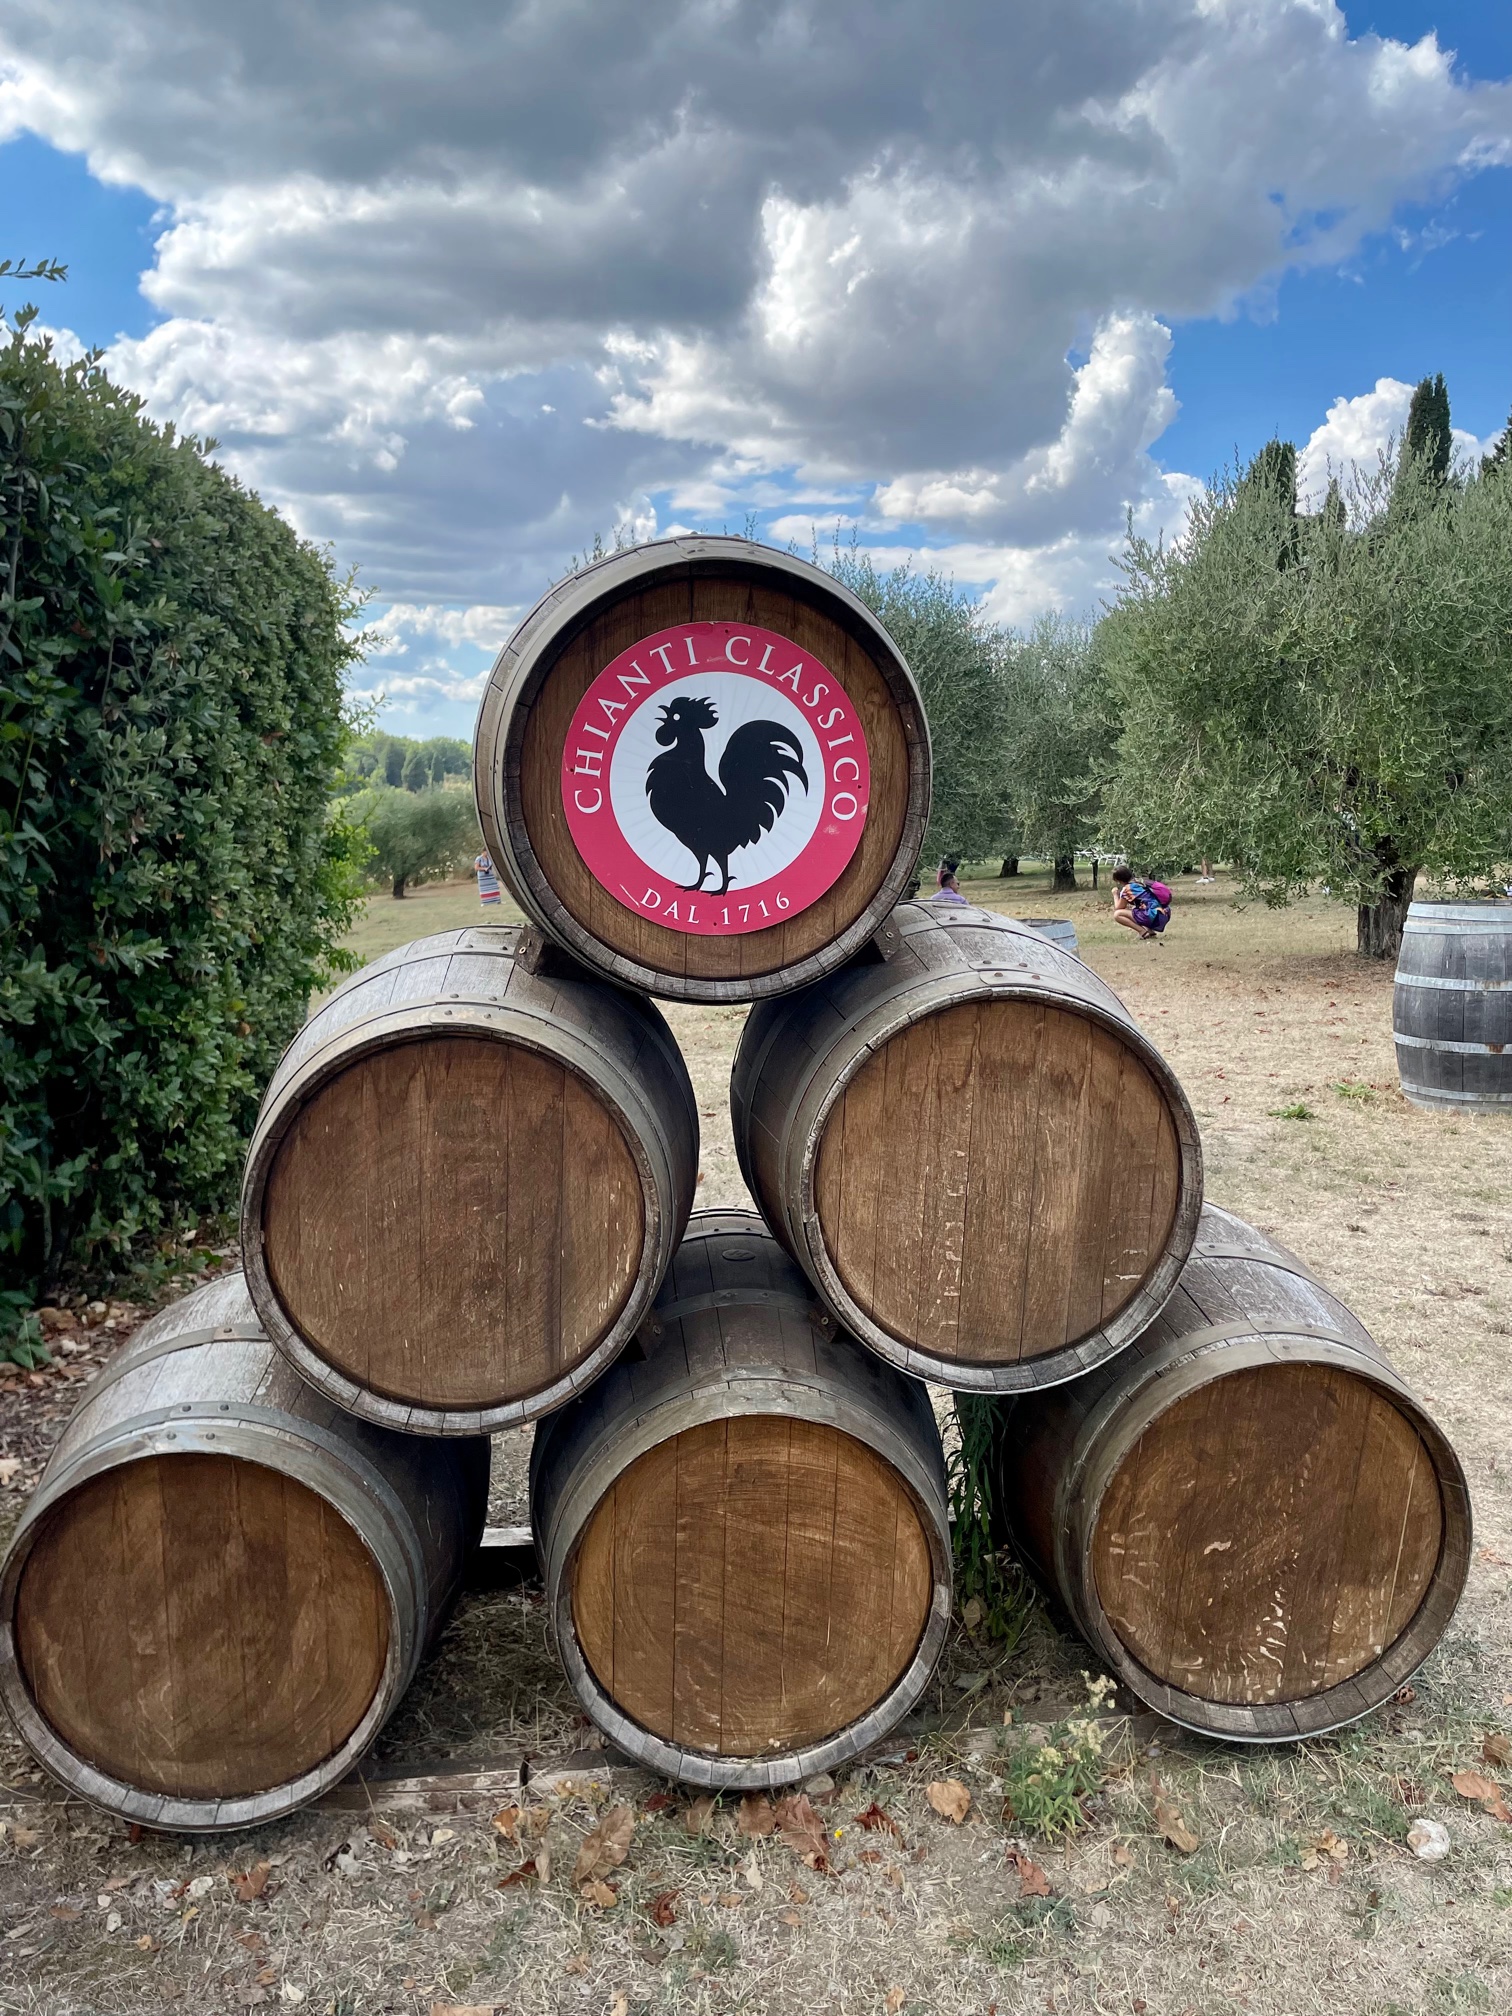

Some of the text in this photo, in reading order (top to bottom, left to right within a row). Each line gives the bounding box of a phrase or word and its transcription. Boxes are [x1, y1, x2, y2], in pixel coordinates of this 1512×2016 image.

[574, 636, 860, 821] CHIANTI CLASSICO
[640, 888, 791, 925] DAL 1716
